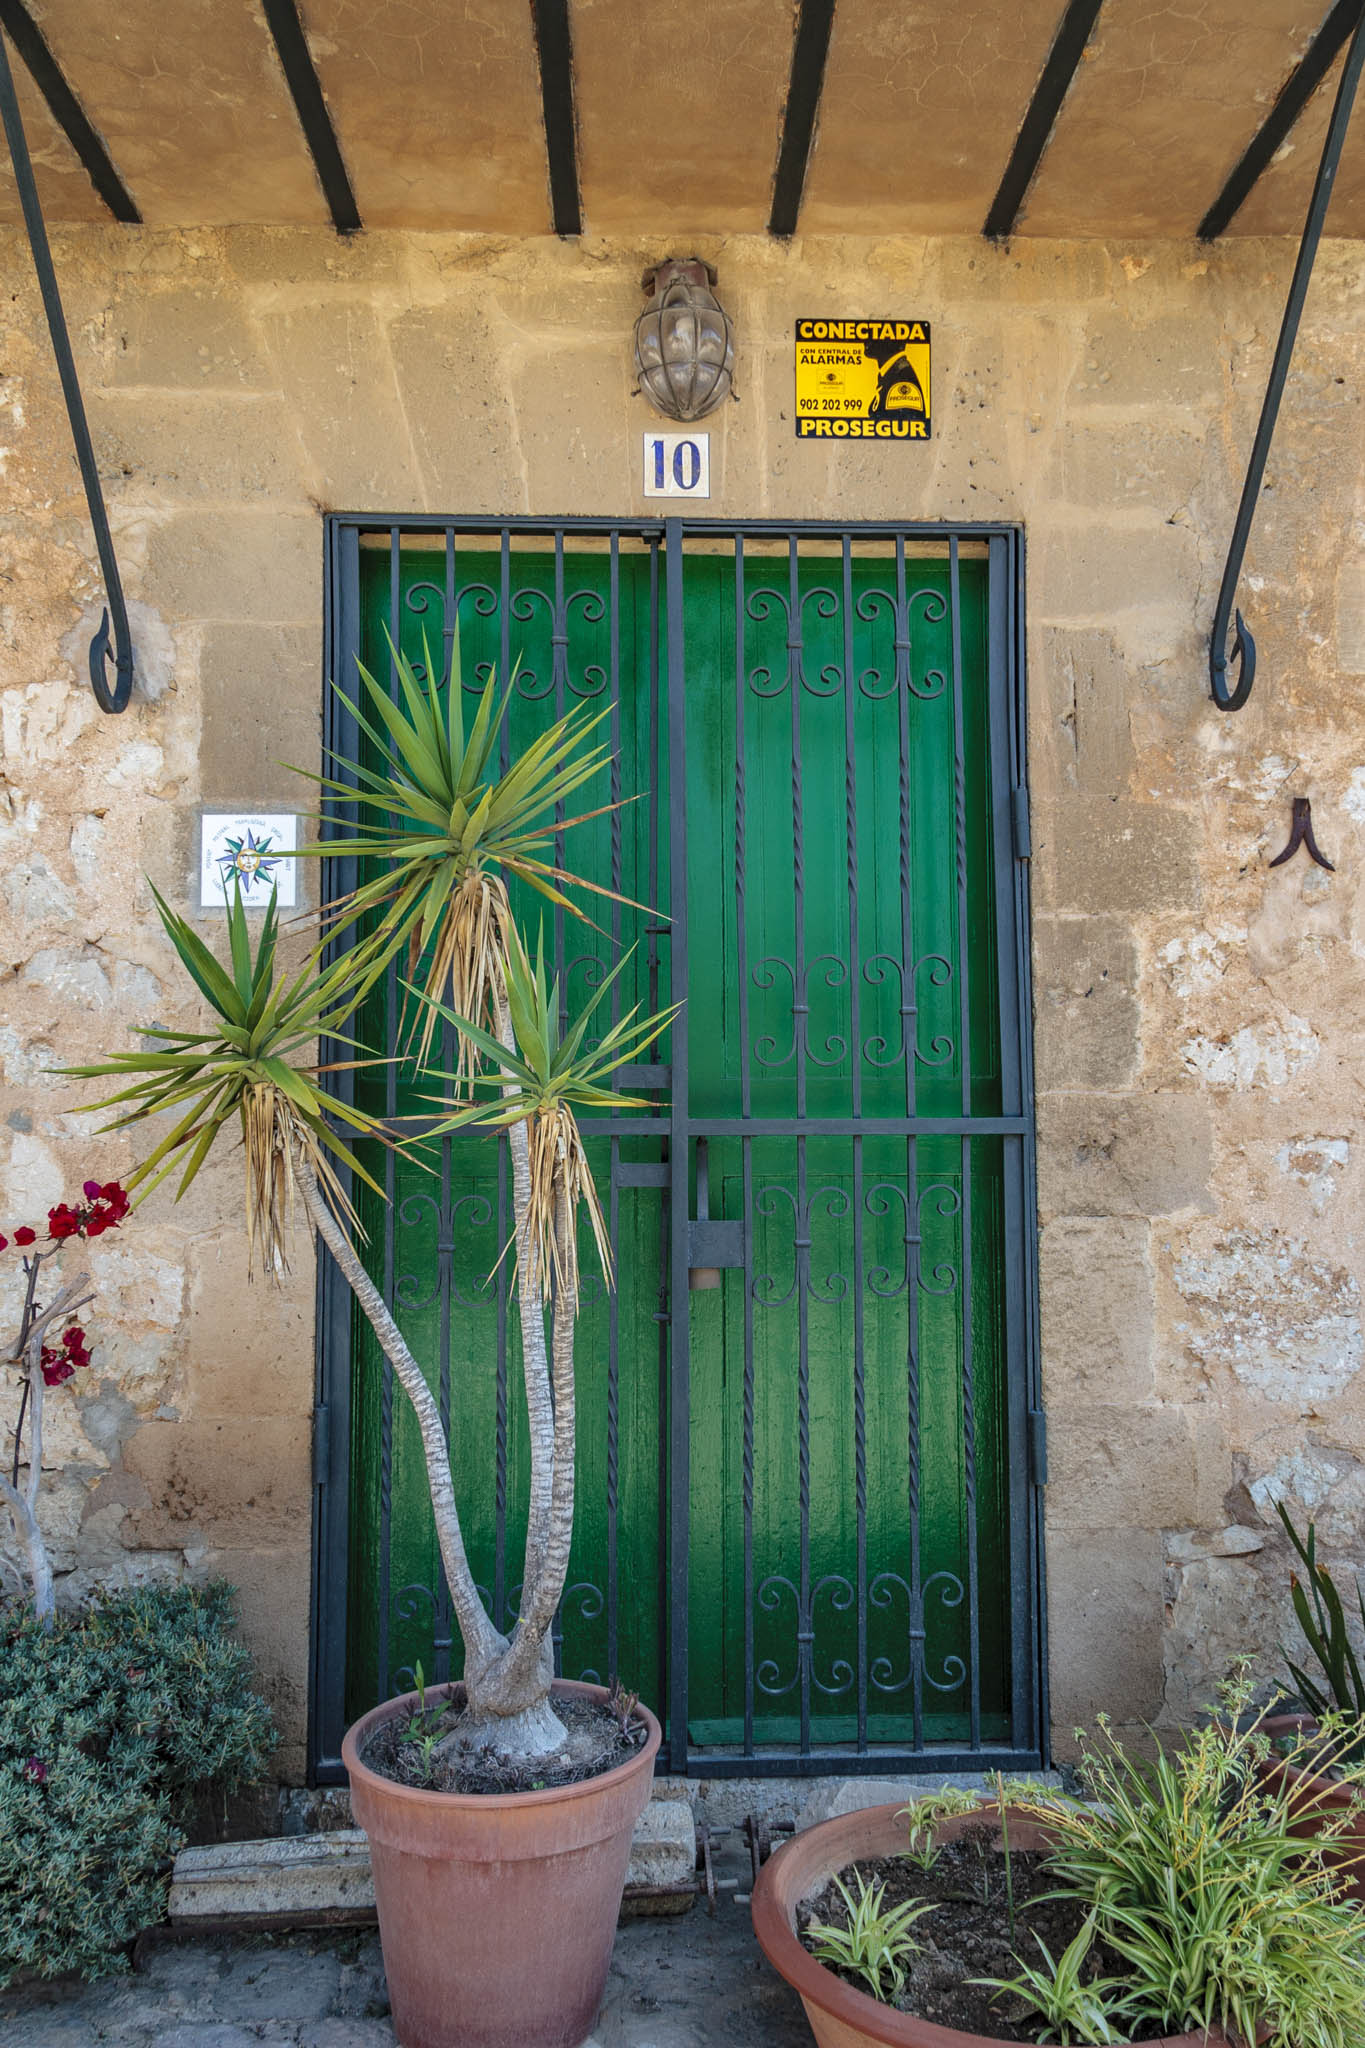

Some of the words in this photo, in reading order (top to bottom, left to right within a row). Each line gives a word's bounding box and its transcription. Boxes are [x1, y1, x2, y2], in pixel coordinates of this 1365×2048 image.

[800, 321, 925, 340] CONECTADA
[800, 355, 862, 365] ALARMAS
[800, 398, 819, 410] 902
[822, 398, 841, 411] 202
[844, 399, 863, 411] 999
[801, 419, 927, 438] PROSEGUR
[651, 440, 701, 490] 10
